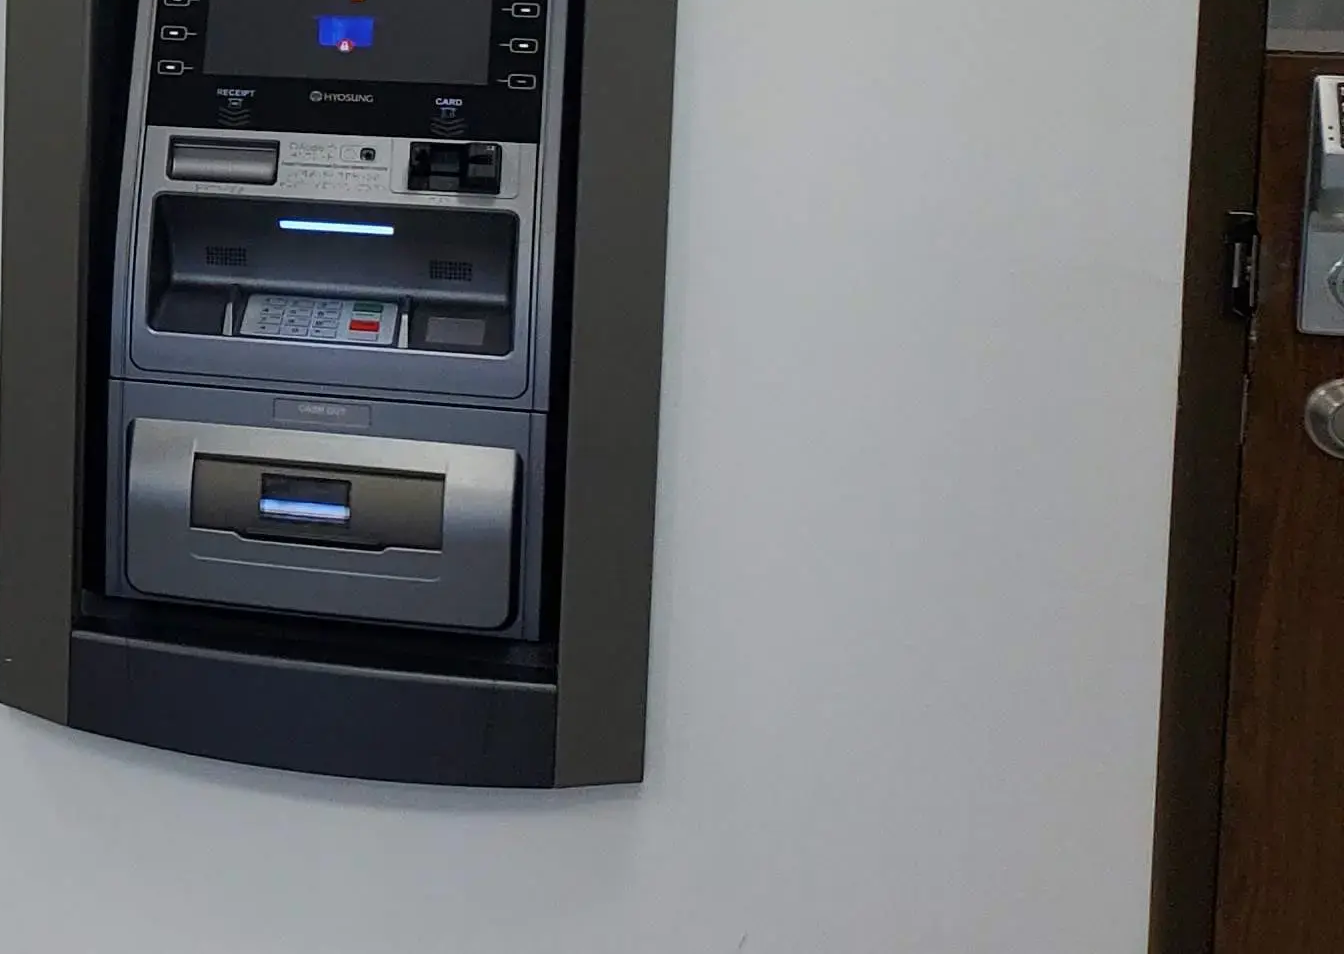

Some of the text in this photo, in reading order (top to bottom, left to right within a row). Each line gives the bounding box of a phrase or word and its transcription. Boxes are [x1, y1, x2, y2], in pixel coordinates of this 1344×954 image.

[216, 88, 256, 97] RECEIPT
[324, 93, 374, 103] HYOSUNG
[435, 97, 463, 106] CARD
